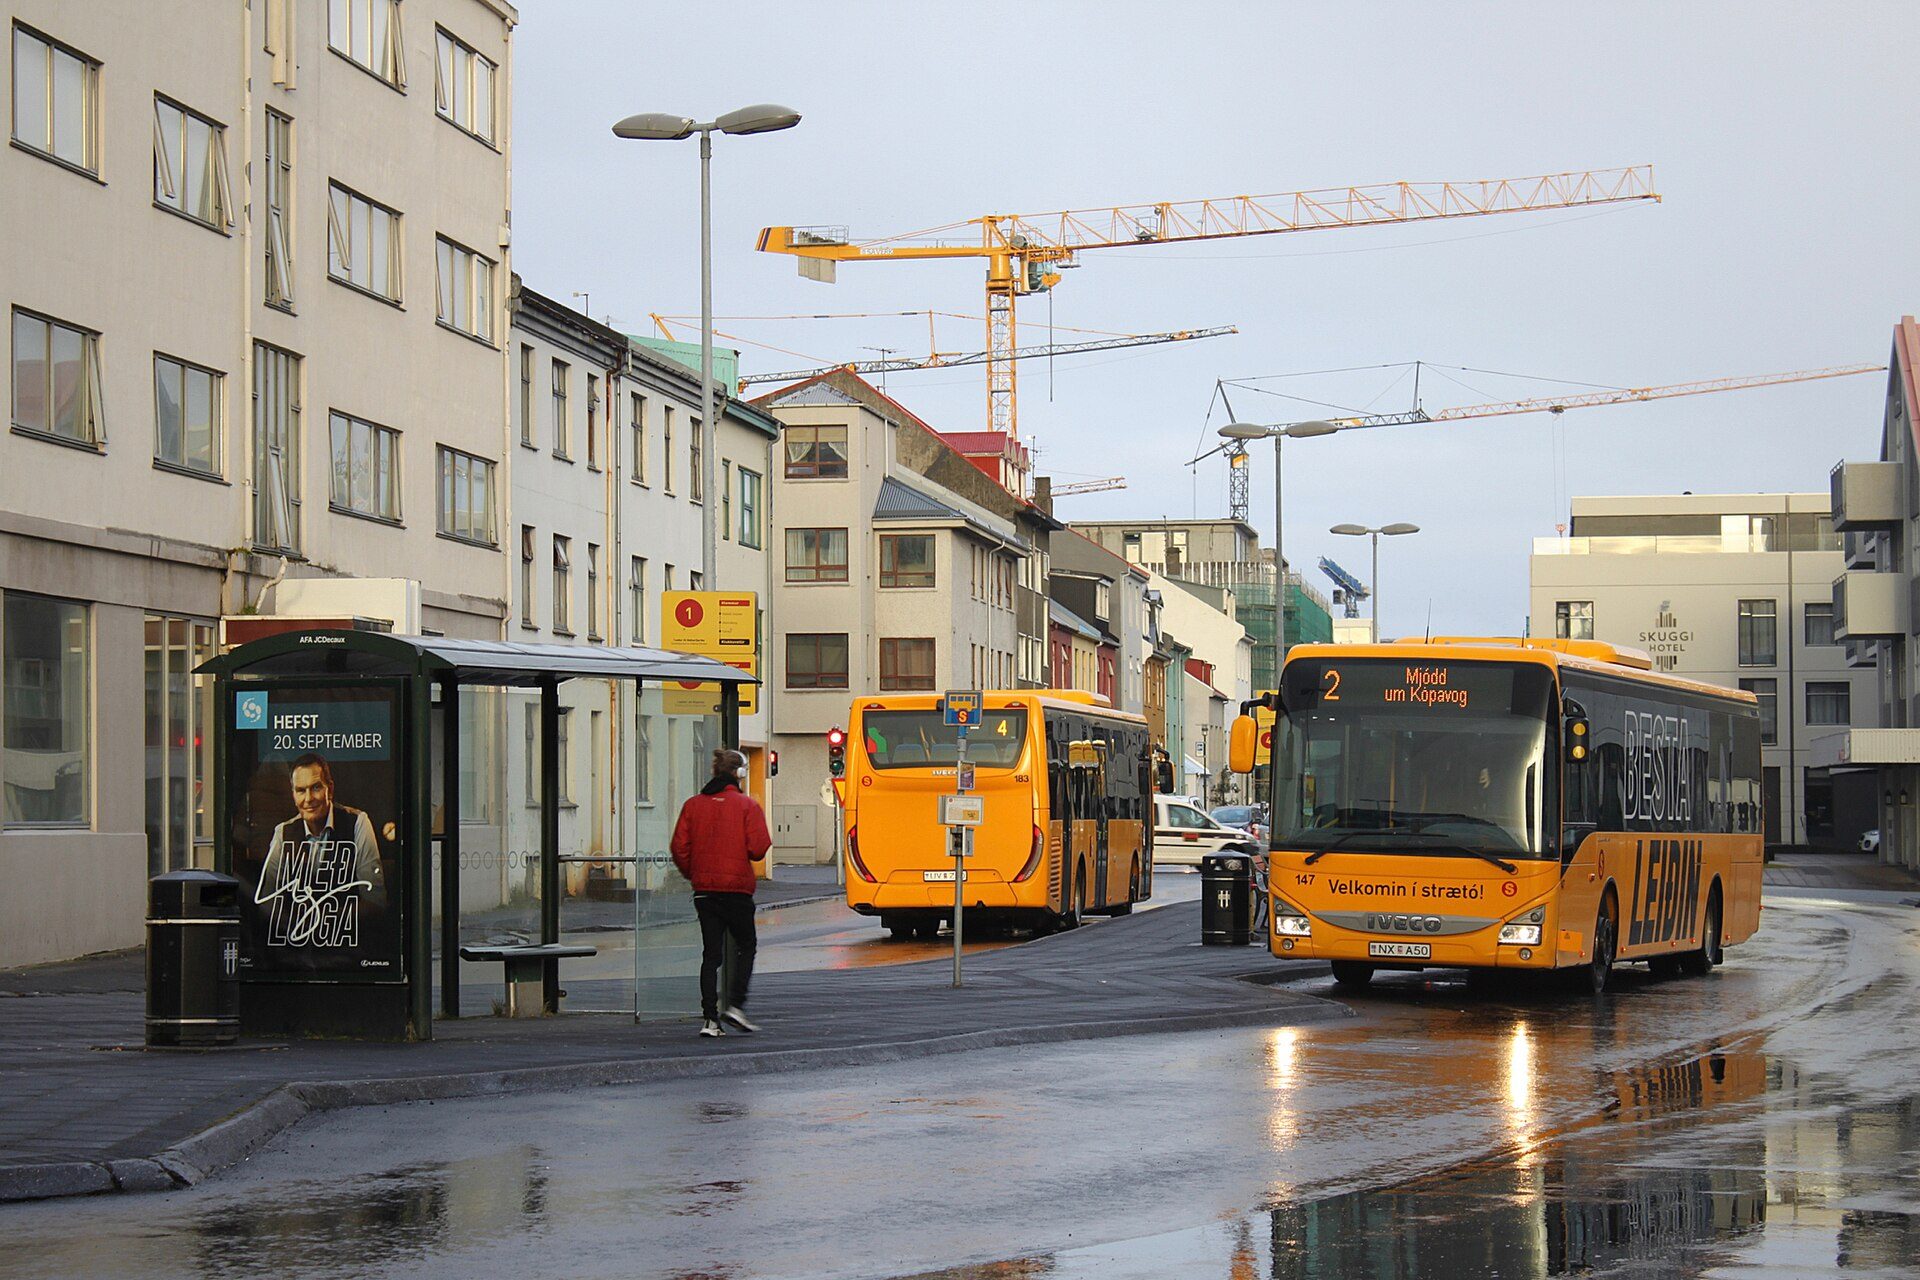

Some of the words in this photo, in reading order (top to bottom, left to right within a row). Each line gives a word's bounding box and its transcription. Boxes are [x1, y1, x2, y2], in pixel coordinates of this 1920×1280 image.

[685, 606, 692, 620] 1
[314, 636, 345, 644] JCDecaux
[1639, 631, 1694, 642] SKUGGI
[1649, 643, 1686, 652] HOTEL
[1323, 669, 1341, 700] 2
[1406, 666, 1447, 688] Mjódd
[1384, 688, 1406, 702] um
[1410, 686, 1468, 708] Kópavog
[274, 714, 319, 730] HEFST
[958, 710, 968, 723] S
[997, 719, 1008, 737] 4
[274, 734, 295, 750] 20.
[298, 733, 382, 750] SEPTEMBER
[1624, 710, 1692, 821] BESTA
[1014, 774, 1029, 783] 183
[275, 840, 358, 893] MEÐ
[1295, 874, 1316, 886] 147
[1328, 878, 1407, 896] Velkomin
[1411, 881, 1417, 896] í
[1421, 881, 1485, 900] strætó!
[1628, 839, 1703, 947] LEIÐIN
[267, 895, 359, 948] LOGA
[1367, 913, 1442, 933] IVECO
[1378, 944, 1395, 954] NX
[1405, 945, 1429, 956] A50
